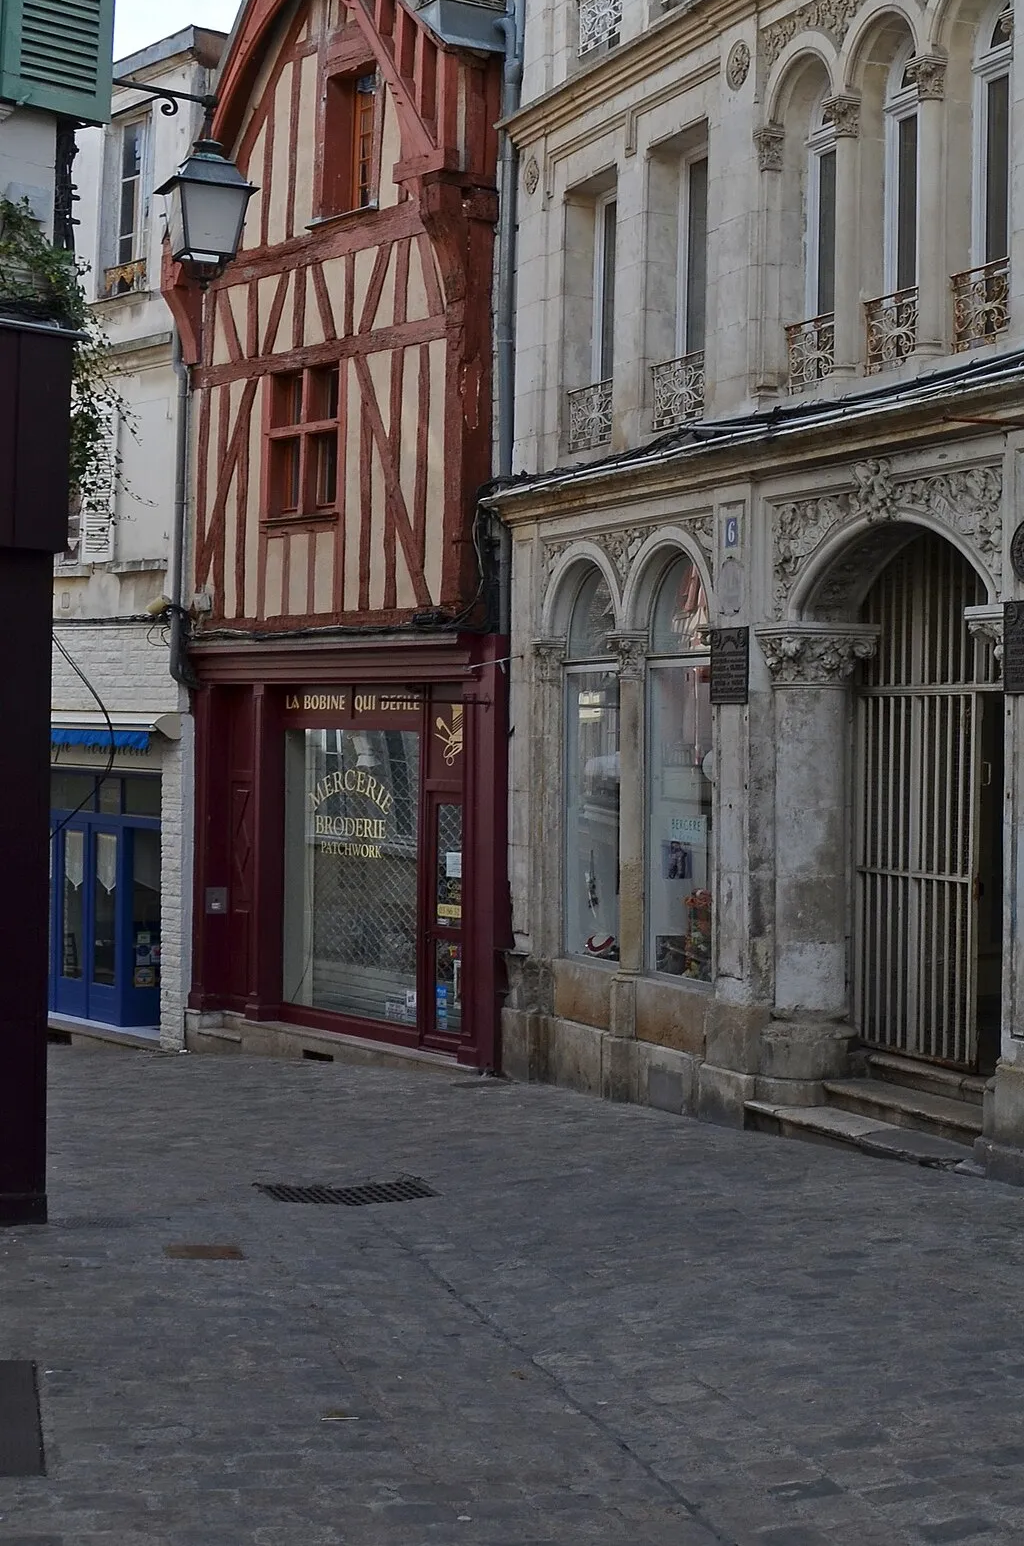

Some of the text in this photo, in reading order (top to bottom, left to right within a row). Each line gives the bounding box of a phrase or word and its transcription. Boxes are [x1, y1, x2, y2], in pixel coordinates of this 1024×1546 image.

[728, 521, 735, 543] 6
[285, 694, 300, 710] LA
[303, 694, 346, 711] BOBINE
[354, 694, 376, 713] QUI
[308, 769, 394, 815] MERCERIE
[315, 815, 387, 839] BRODERIE
[320, 840, 382, 859] PATCHWORK
